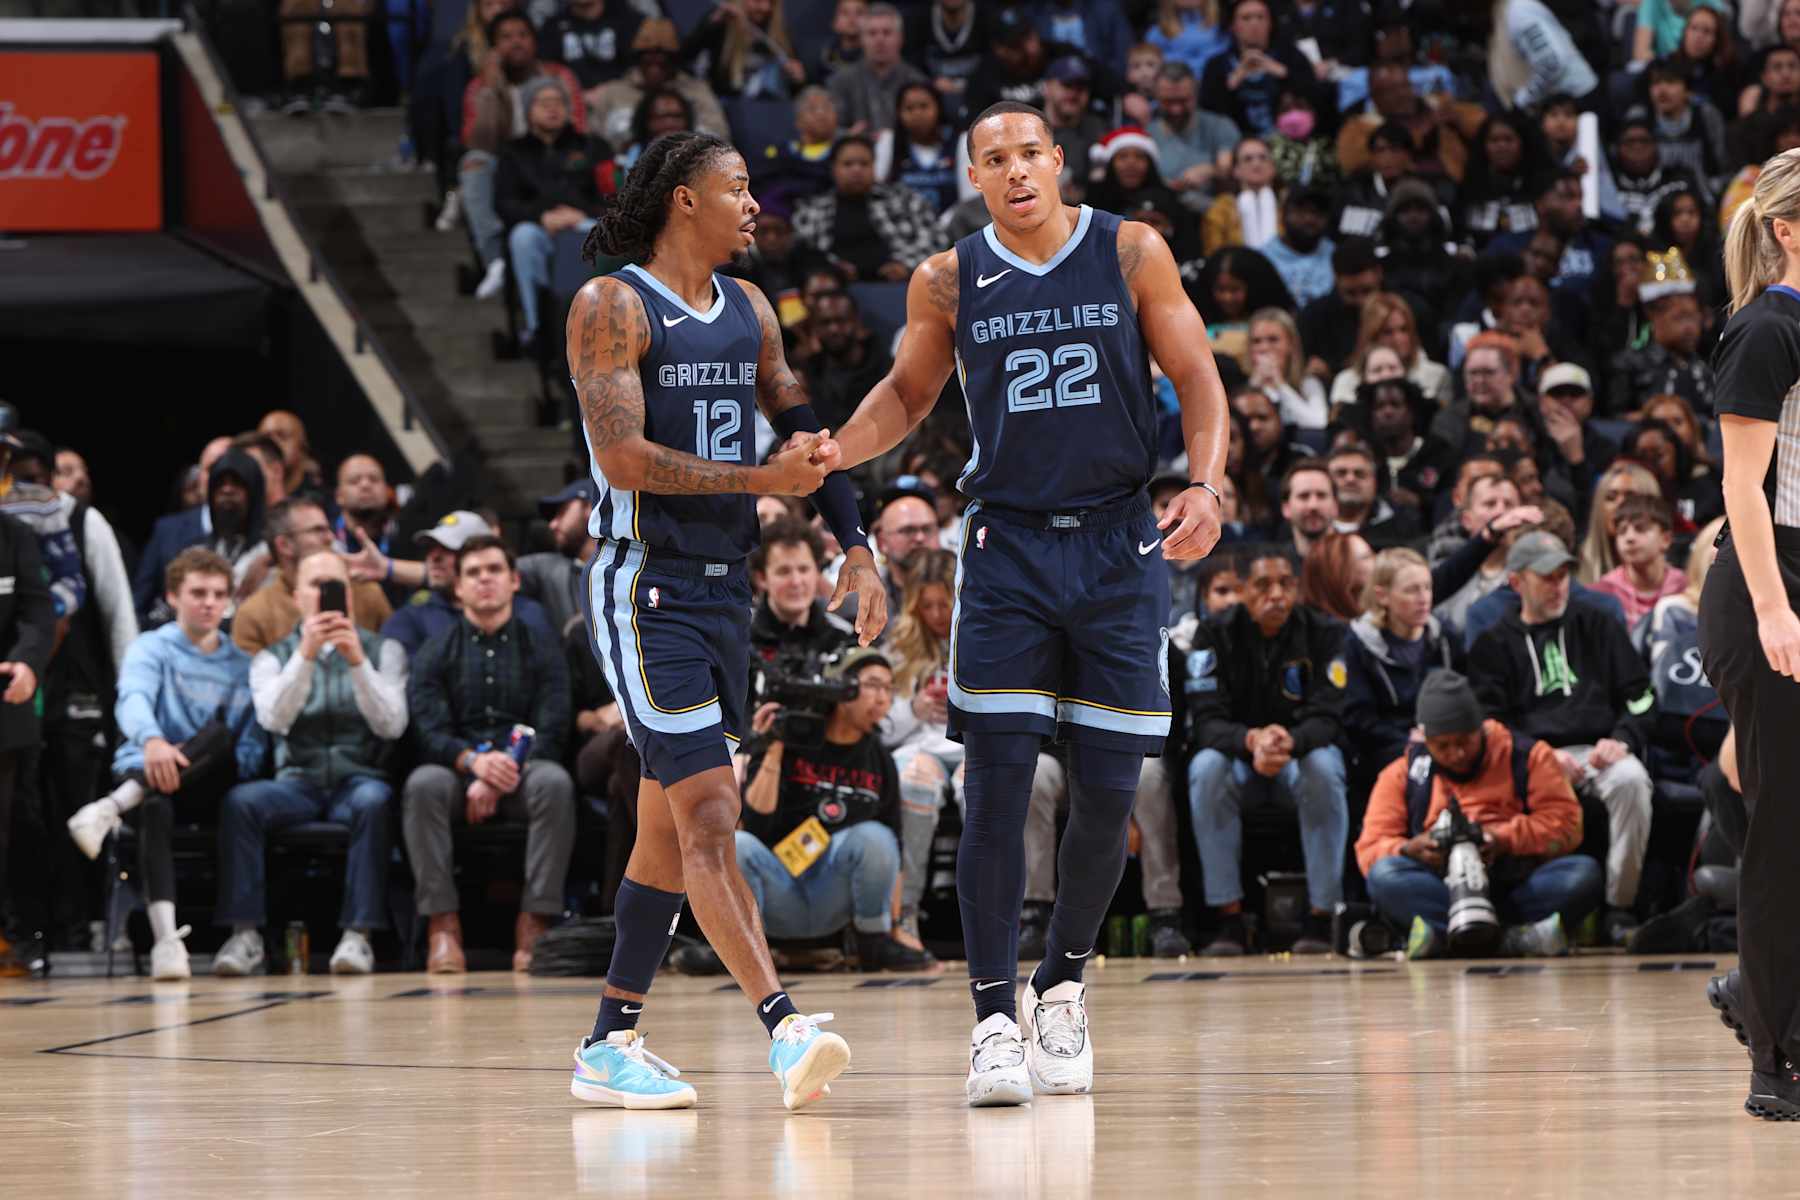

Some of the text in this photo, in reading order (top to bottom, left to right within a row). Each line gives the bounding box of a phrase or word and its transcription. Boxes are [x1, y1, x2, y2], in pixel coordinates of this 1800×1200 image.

[0, 101, 127, 180] one
[972, 303, 1119, 344] GRIZZLIES
[1005, 342, 1101, 413] 22
[693, 399, 741, 461] 12
